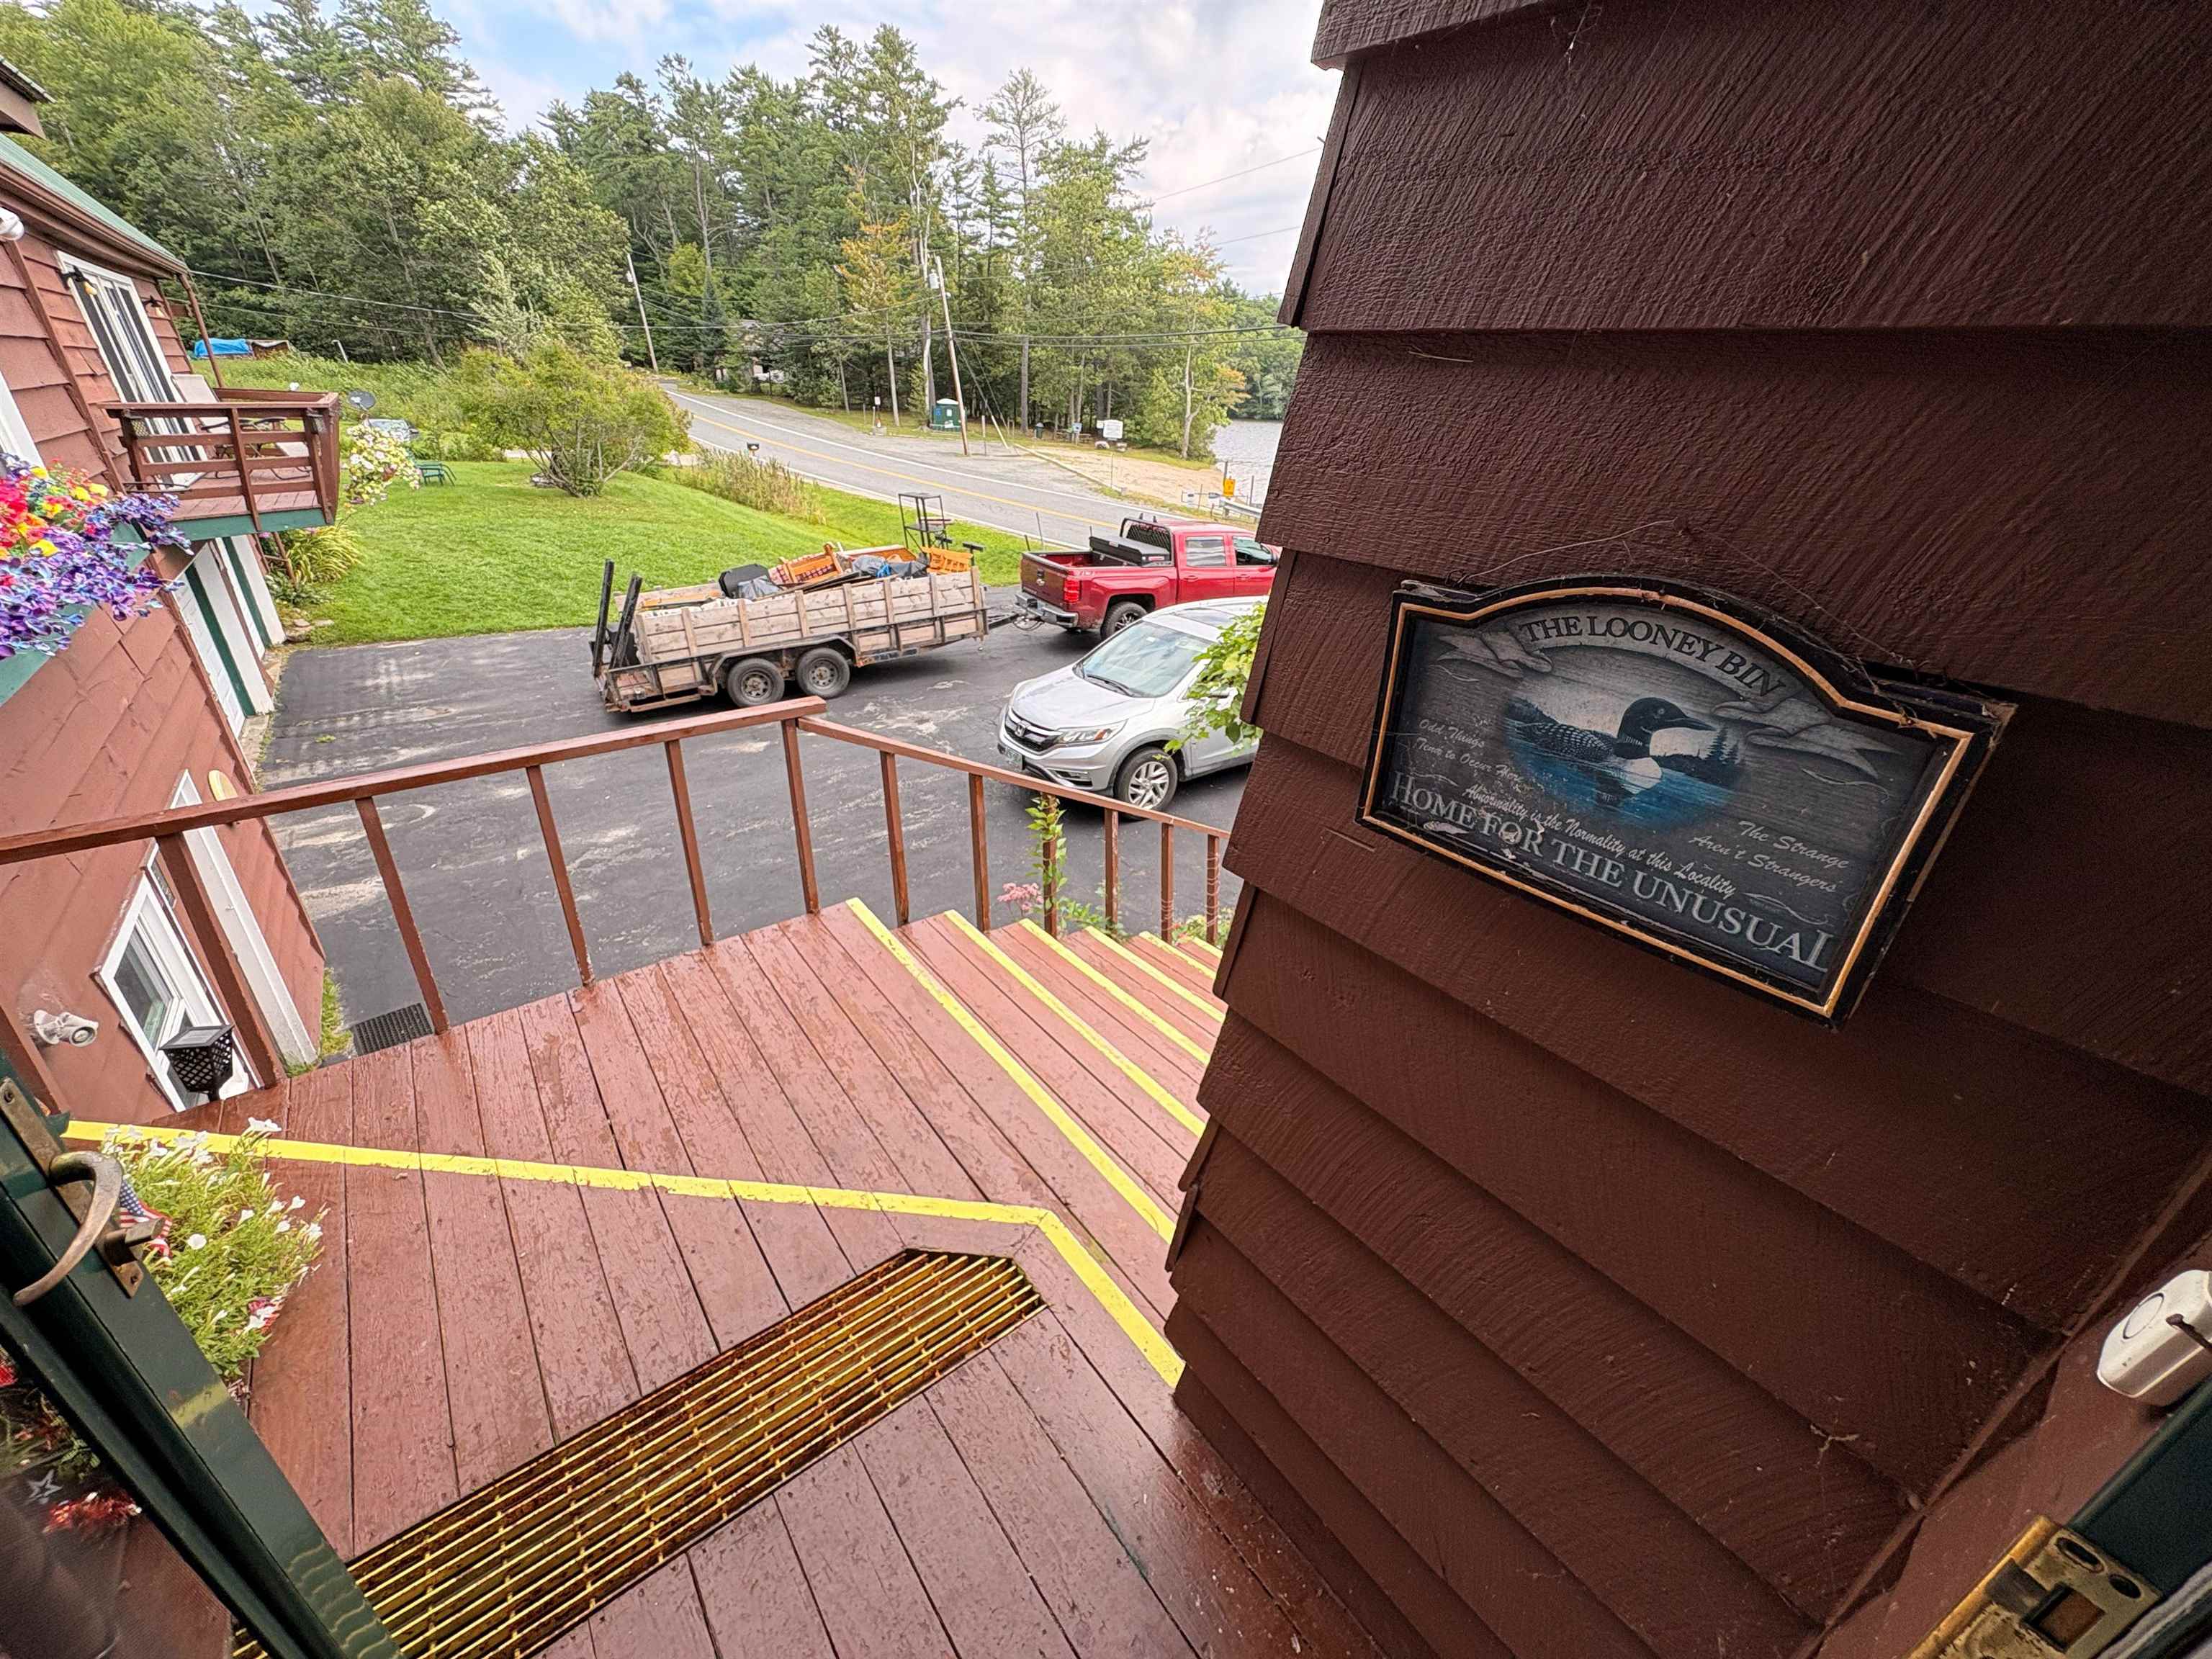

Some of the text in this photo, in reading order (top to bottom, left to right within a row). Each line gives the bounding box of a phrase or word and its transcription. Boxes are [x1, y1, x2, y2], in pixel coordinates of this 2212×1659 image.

[1519, 616, 1786, 696] THE LOONEY BIN
[1419, 719, 1485, 749] Odd Things
[1445, 750, 1456, 760] to
[1460, 753, 1492, 770] Occur
[1389, 771, 1478, 830] HOME
[1480, 810, 1544, 857] FOR
[1551, 837, 1625, 886] THE
[1462, 783, 1737, 900] Abnormality is the Normality at this Locality
[1738, 820, 1849, 868] The Strange
[1689, 835, 1837, 893] Aren't Strangers
